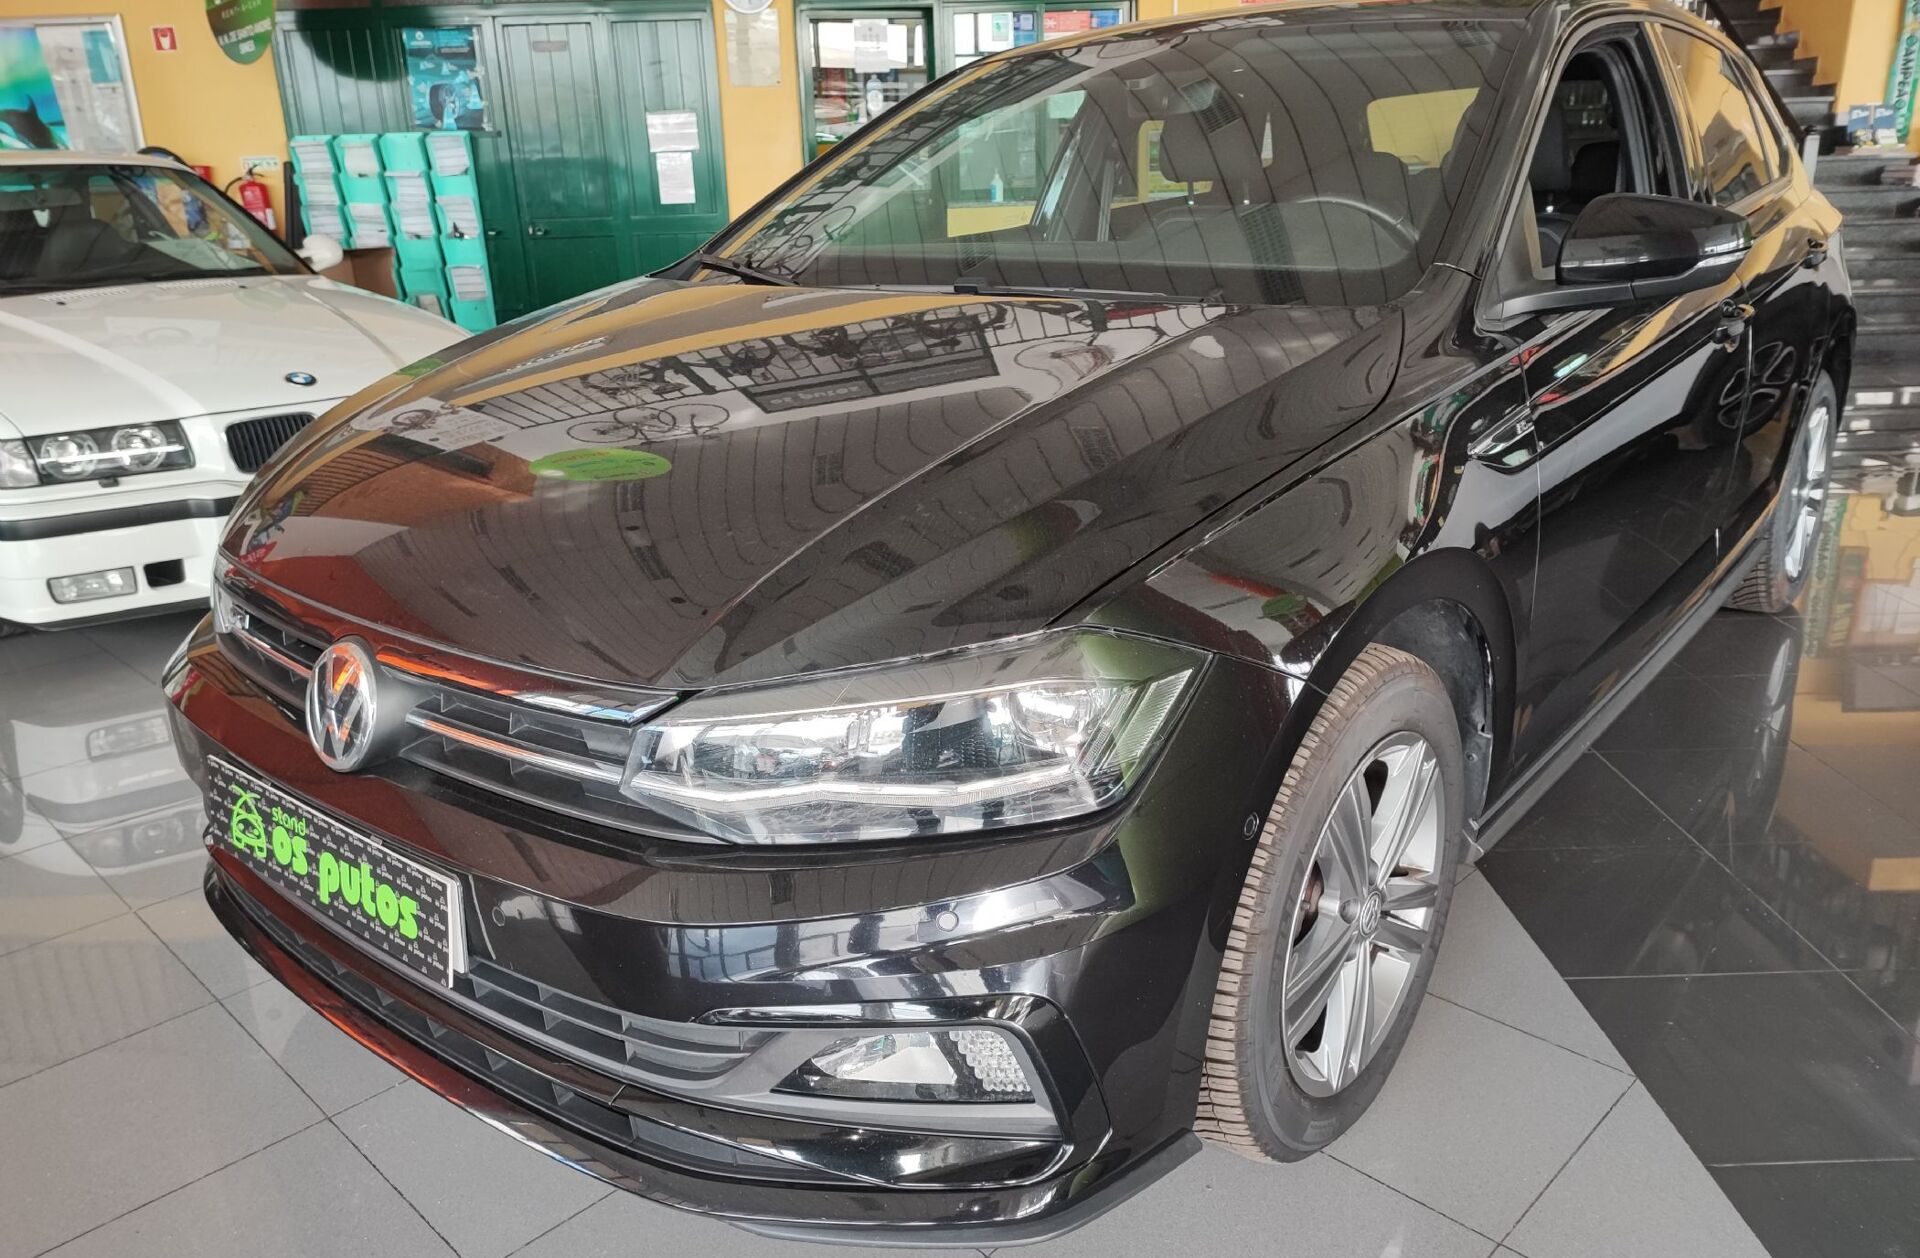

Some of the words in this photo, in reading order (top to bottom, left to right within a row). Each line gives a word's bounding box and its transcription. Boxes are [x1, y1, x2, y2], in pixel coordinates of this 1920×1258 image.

[271, 806, 306, 836] stand
[272, 826, 309, 876] os
[319, 852, 419, 940] putos
